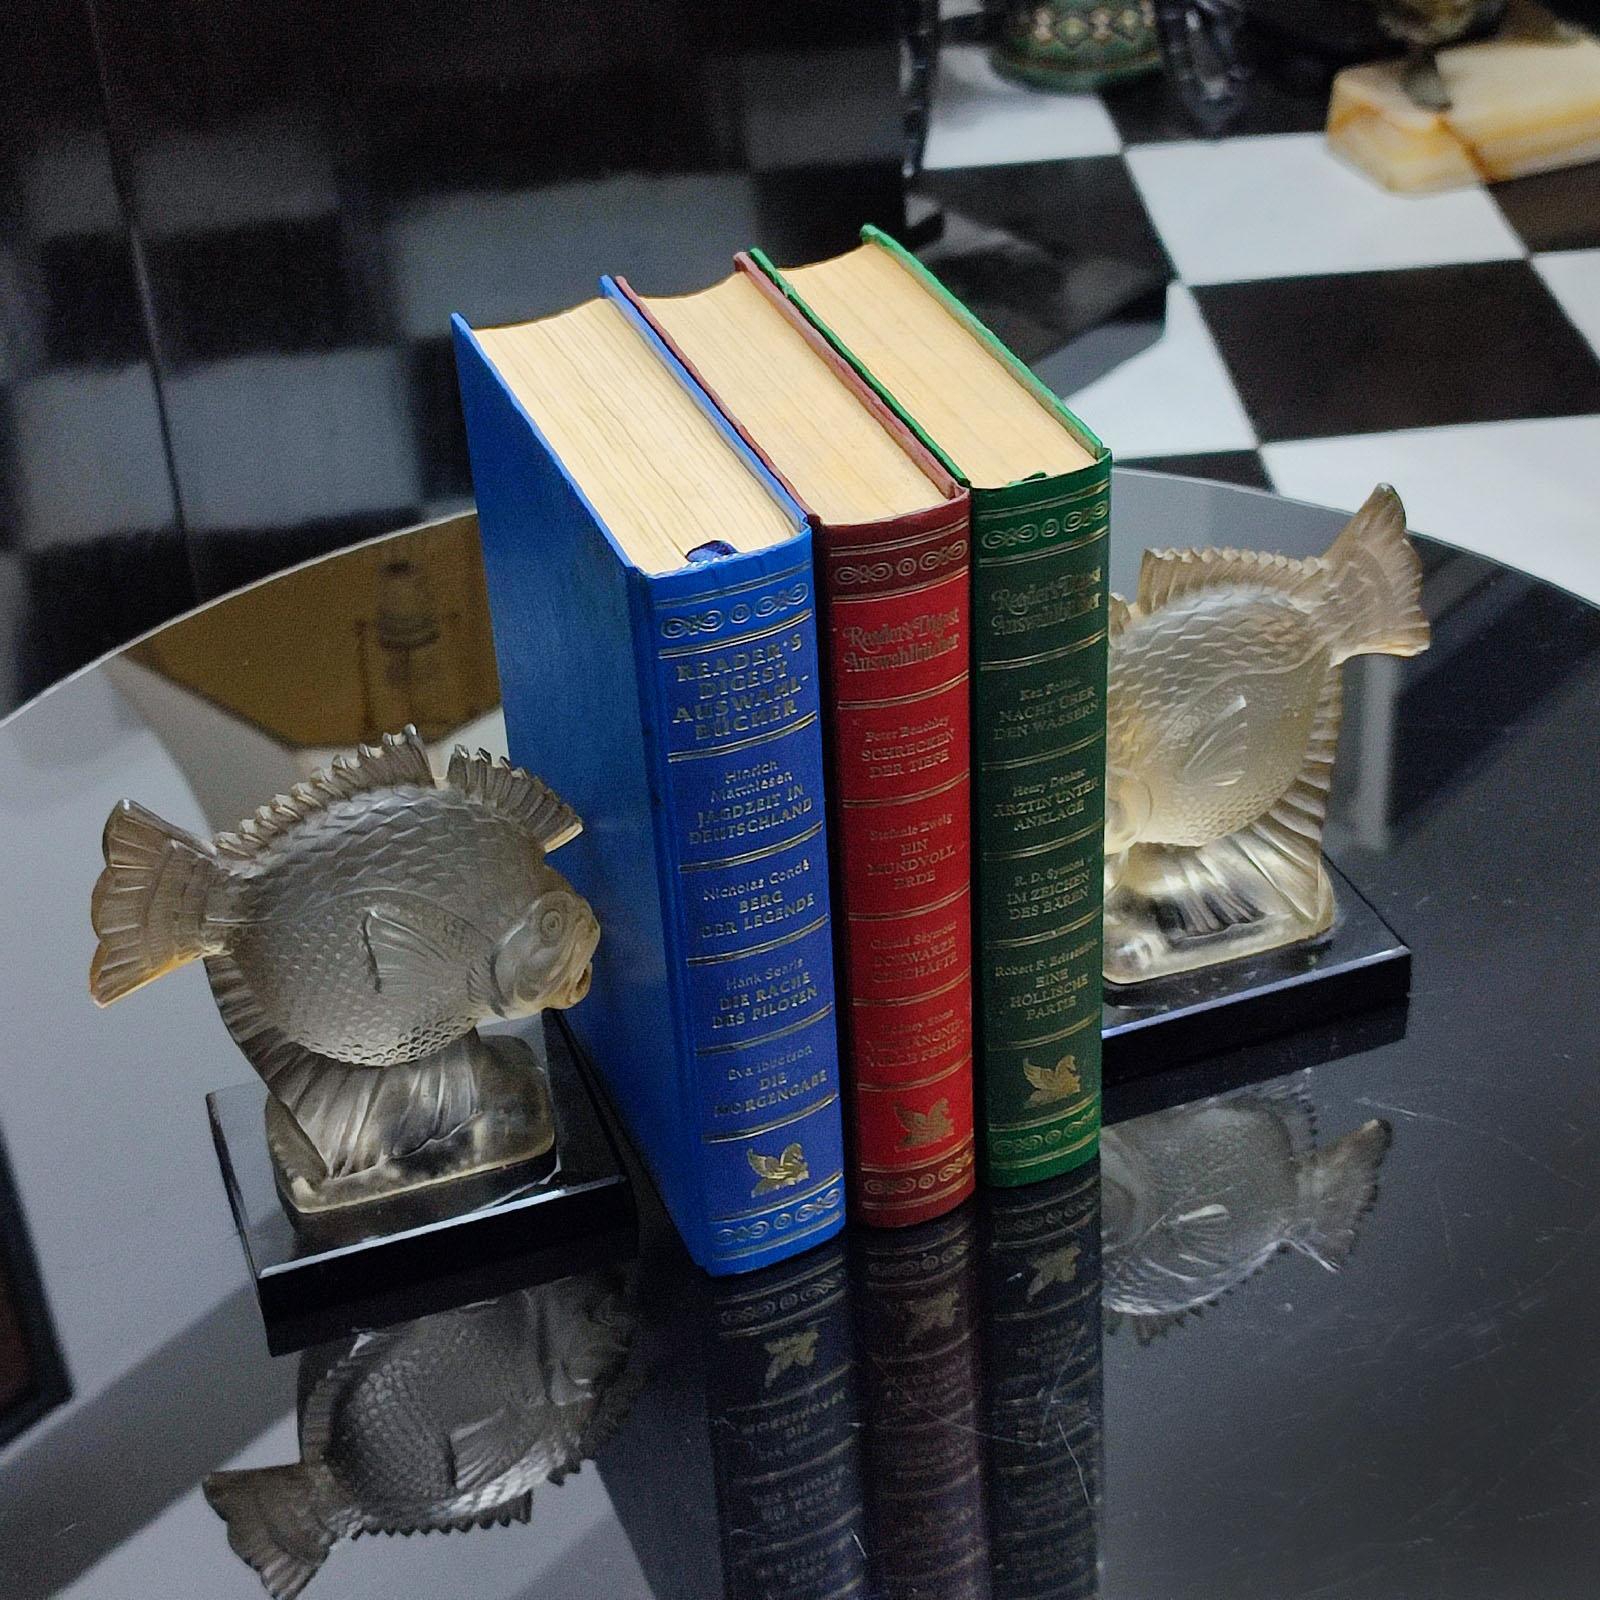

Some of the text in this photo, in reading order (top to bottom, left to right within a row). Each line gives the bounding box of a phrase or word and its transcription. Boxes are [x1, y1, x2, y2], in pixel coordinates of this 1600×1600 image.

[676, 633, 803, 682] READER'S
[699, 661, 788, 700] DIGEST
[672, 674, 809, 724] AUSWAHL-
[993, 723, 1028, 740] DEN
[861, 728, 955, 762] SCHRECKEN
[869, 763, 905, 779] DER
[787, 784, 804, 802] IN
[689, 798, 813, 845] DEUTSCHLAND
[901, 838, 929, 856] EIN
[703, 878, 765, 901] Nicholas
[894, 870, 936, 890] ERDE
[1030, 869, 1090, 900] ZEICHEN
[739, 890, 784, 914] BERG
[1009, 904, 1039, 920] DES
[701, 892, 815, 939] DER LEGENDE
[726, 973, 762, 991] Hank
[1035, 968, 1069, 989] EINE
[720, 971, 811, 1011] DIE RACHE
[712, 984, 818, 1029] DES PILOTEN
[1026, 995, 1077, 1020] PARTIE
[728, 1065, 754, 1081] Eva
[759, 1071, 788, 1091] DIE
